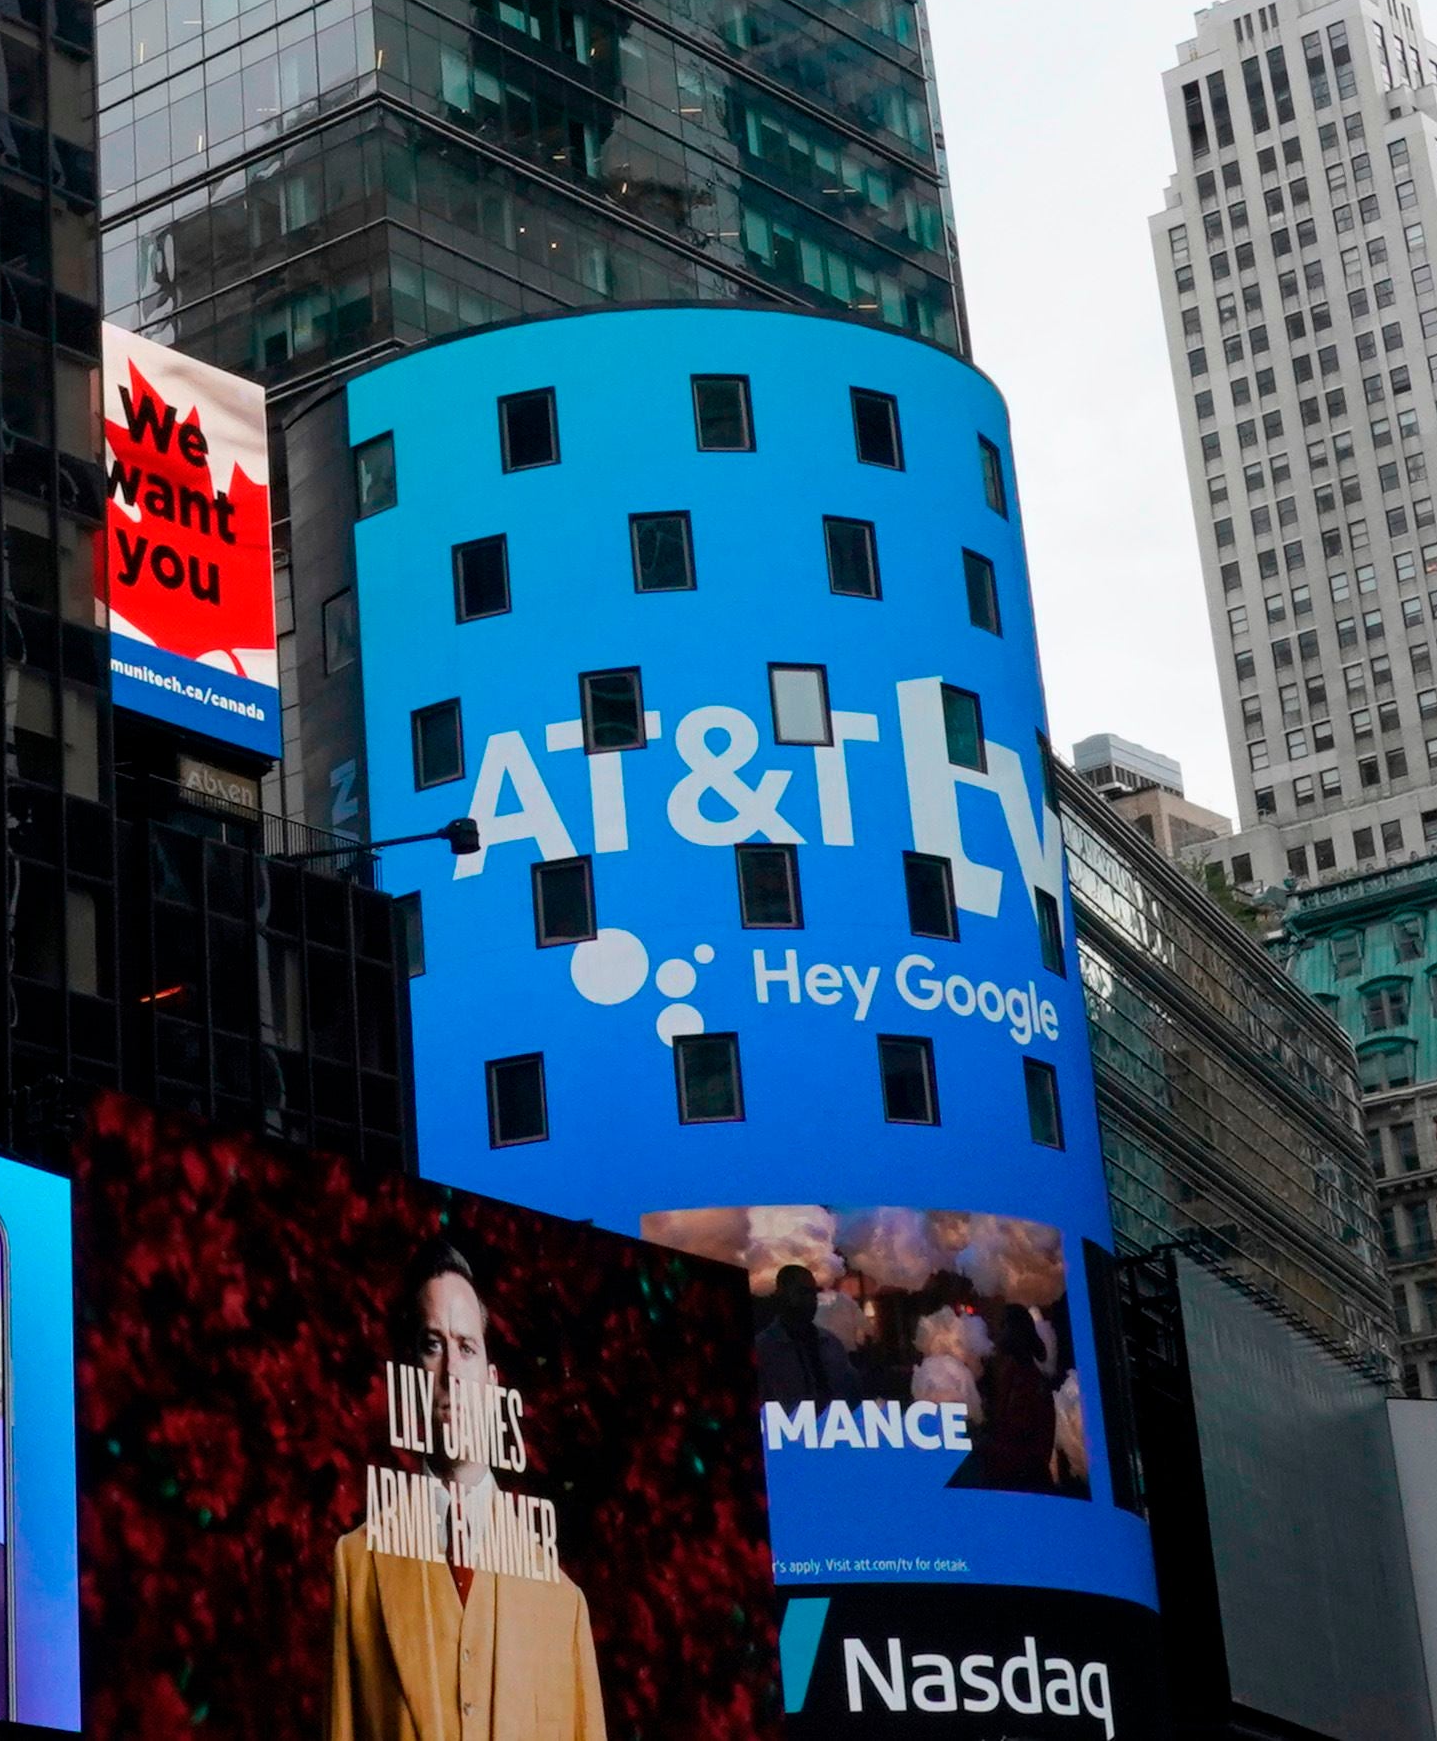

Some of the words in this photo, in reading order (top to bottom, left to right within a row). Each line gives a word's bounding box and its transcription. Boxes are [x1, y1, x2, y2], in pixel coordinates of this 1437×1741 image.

[116, 382, 210, 468] We
[108, 457, 238, 546] want
[115, 525, 222, 607] you
[451, 704, 881, 882] AT&T
[752, 947, 881, 1024] Hey
[894, 952, 1059, 1046] Google
[385, 1359, 436, 1455] LILY
[442, 1374, 528, 1475] JAMES
[761, 1398, 974, 1453] MANCE
[365, 1463, 447, 1564] ARMIE
[450, 1481, 561, 1585] HAMMER
[788, 1559, 824, 1576] apply.
[825, 1557, 852, 1572] Visit
[853, 1556, 913, 1574] att.com/tv
[915, 1555, 931, 1571] for
[933, 1557, 971, 1573] details.
[842, 1634, 1115, 1741] Nasdaq
